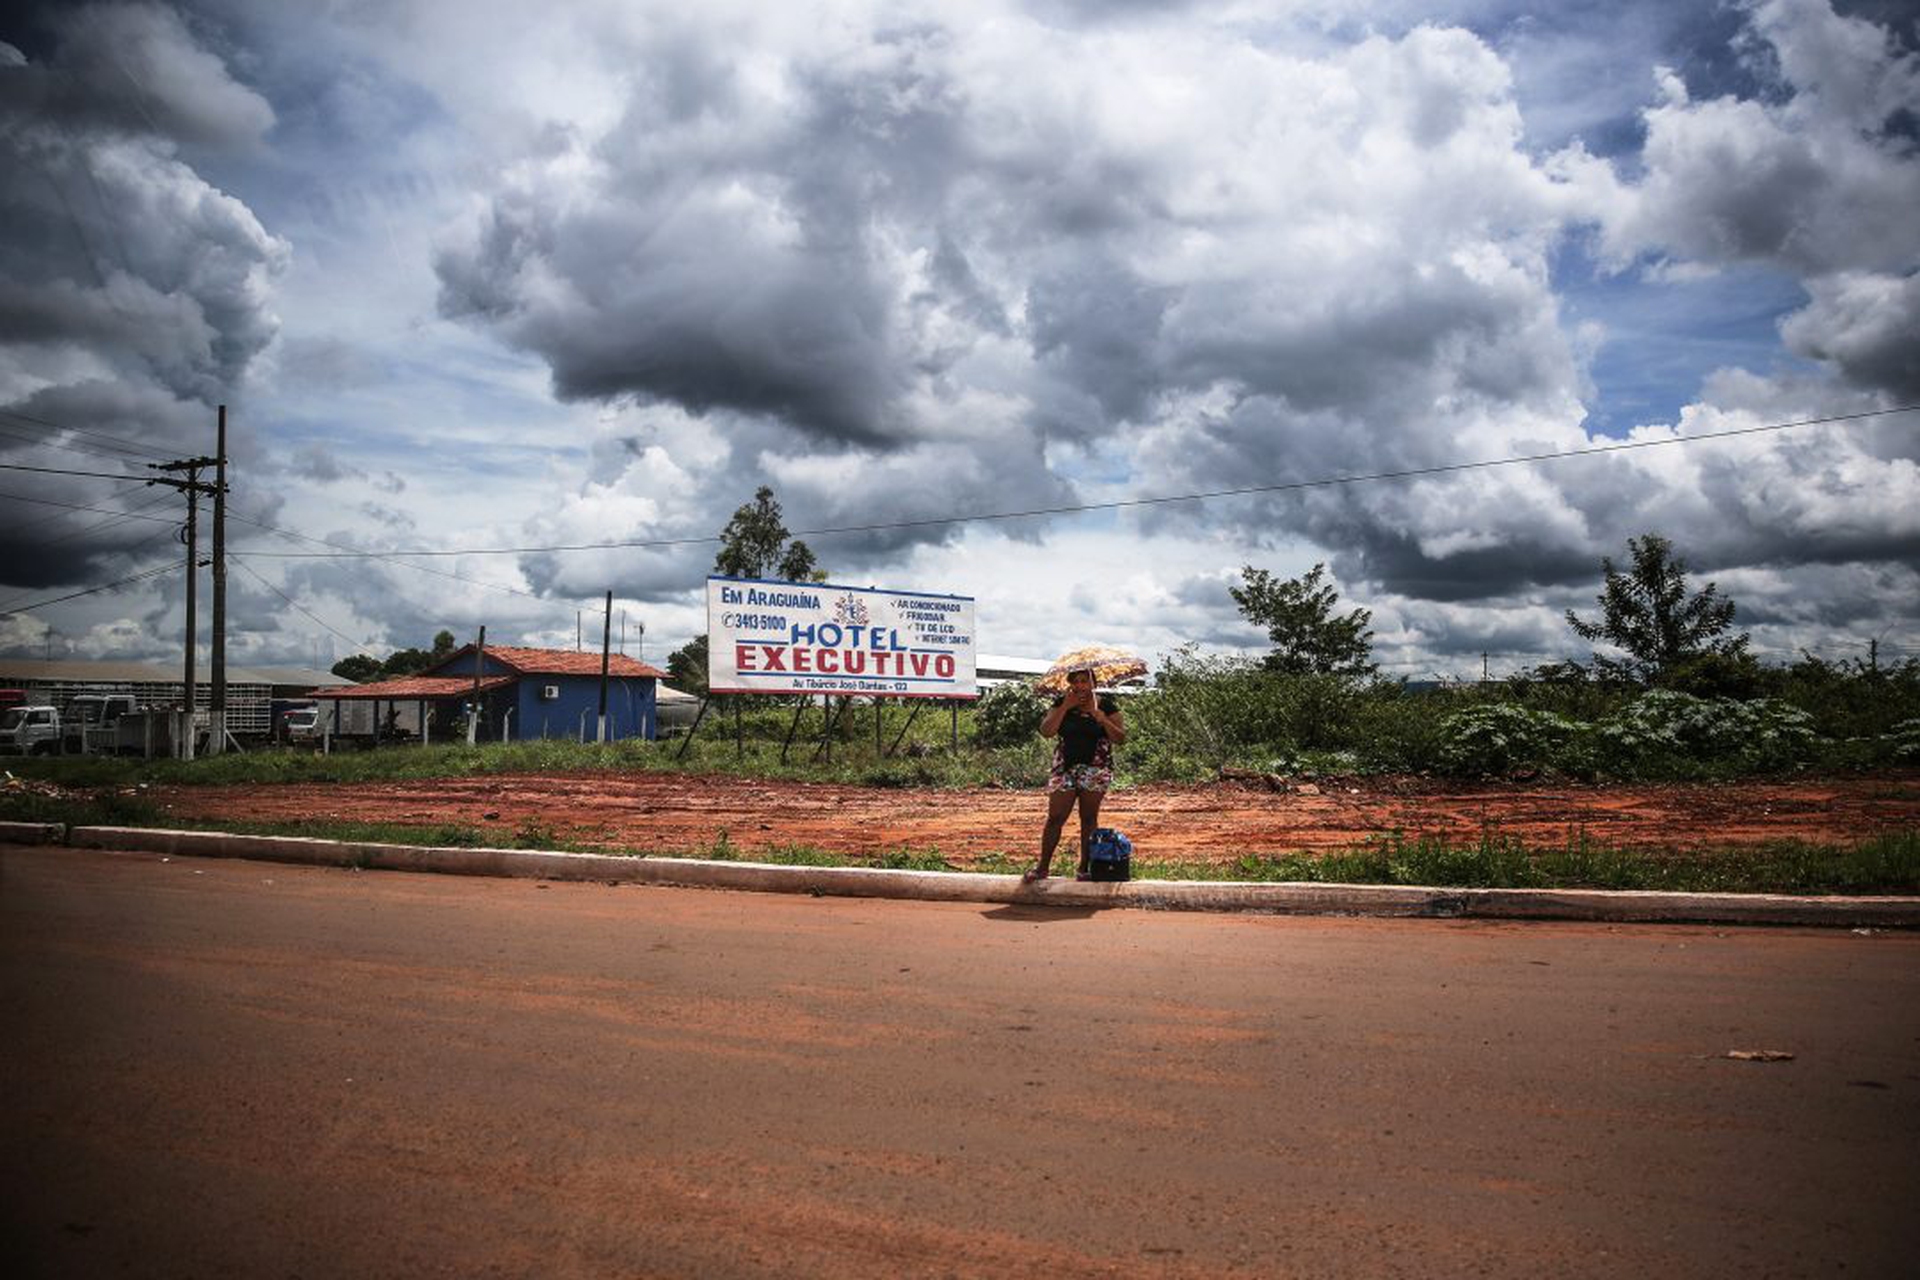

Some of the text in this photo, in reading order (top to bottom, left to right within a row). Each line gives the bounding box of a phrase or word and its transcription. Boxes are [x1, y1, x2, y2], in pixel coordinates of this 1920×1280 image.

[722, 587, 821, 609] EM ARAGUAÍNA
[791, 623, 909, 652] HOTEL
[736, 645, 955, 678] EXECUTIVO
